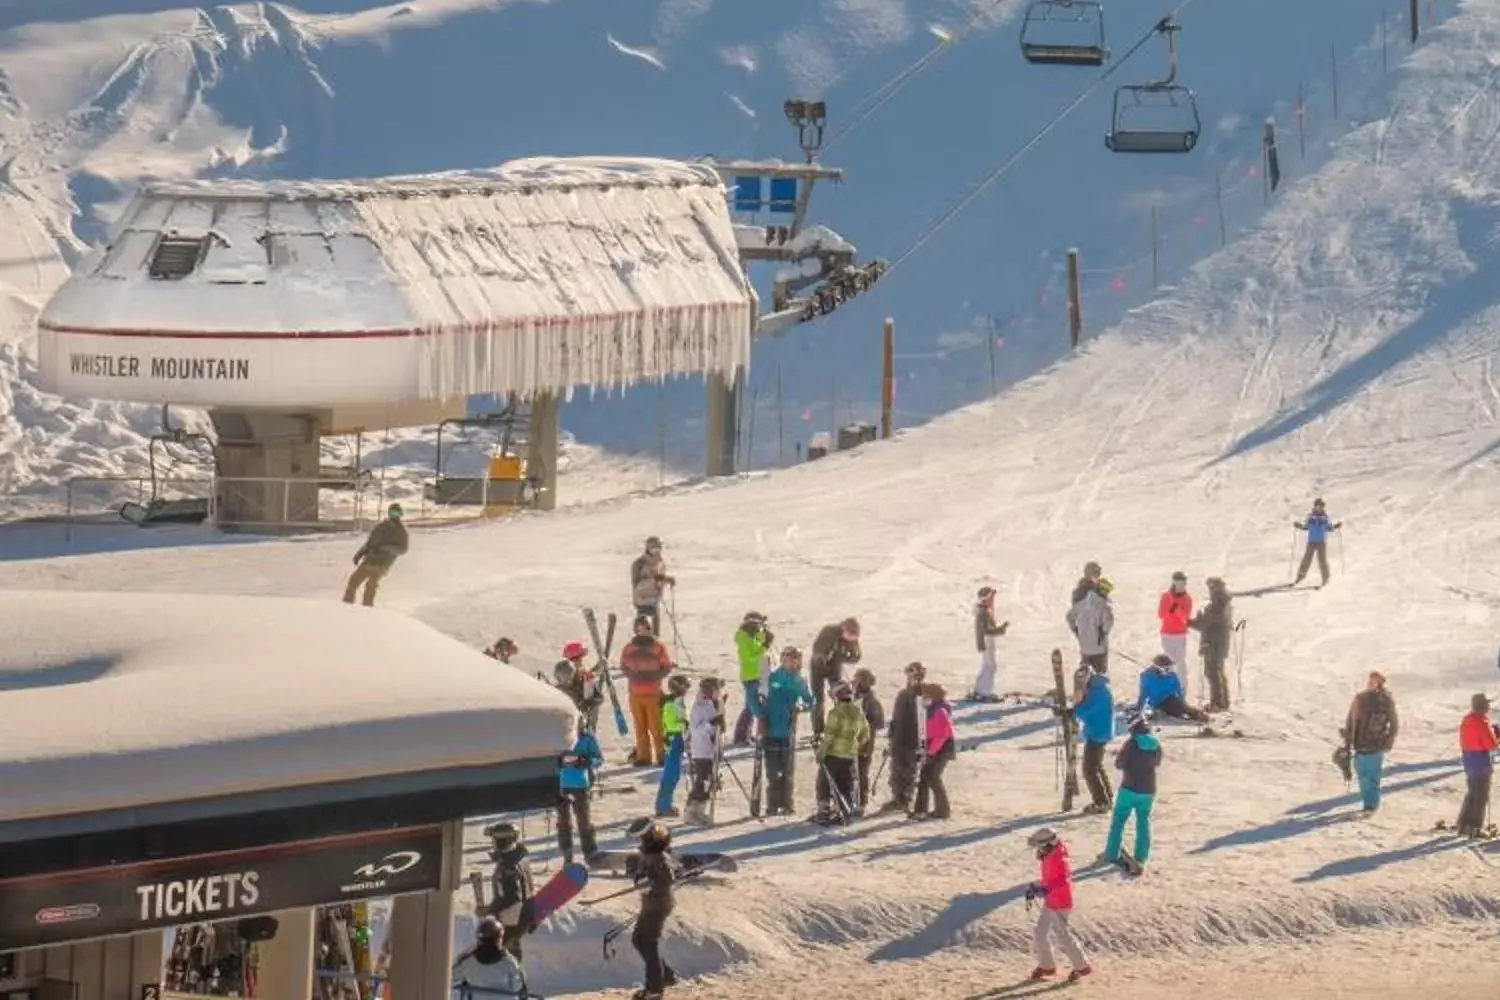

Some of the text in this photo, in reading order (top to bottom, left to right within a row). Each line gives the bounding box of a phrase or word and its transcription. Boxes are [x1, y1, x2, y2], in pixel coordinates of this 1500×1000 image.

[69, 353, 250, 380] WHISTLER MOUNTAIN
[136, 870, 261, 921] TICKETS
